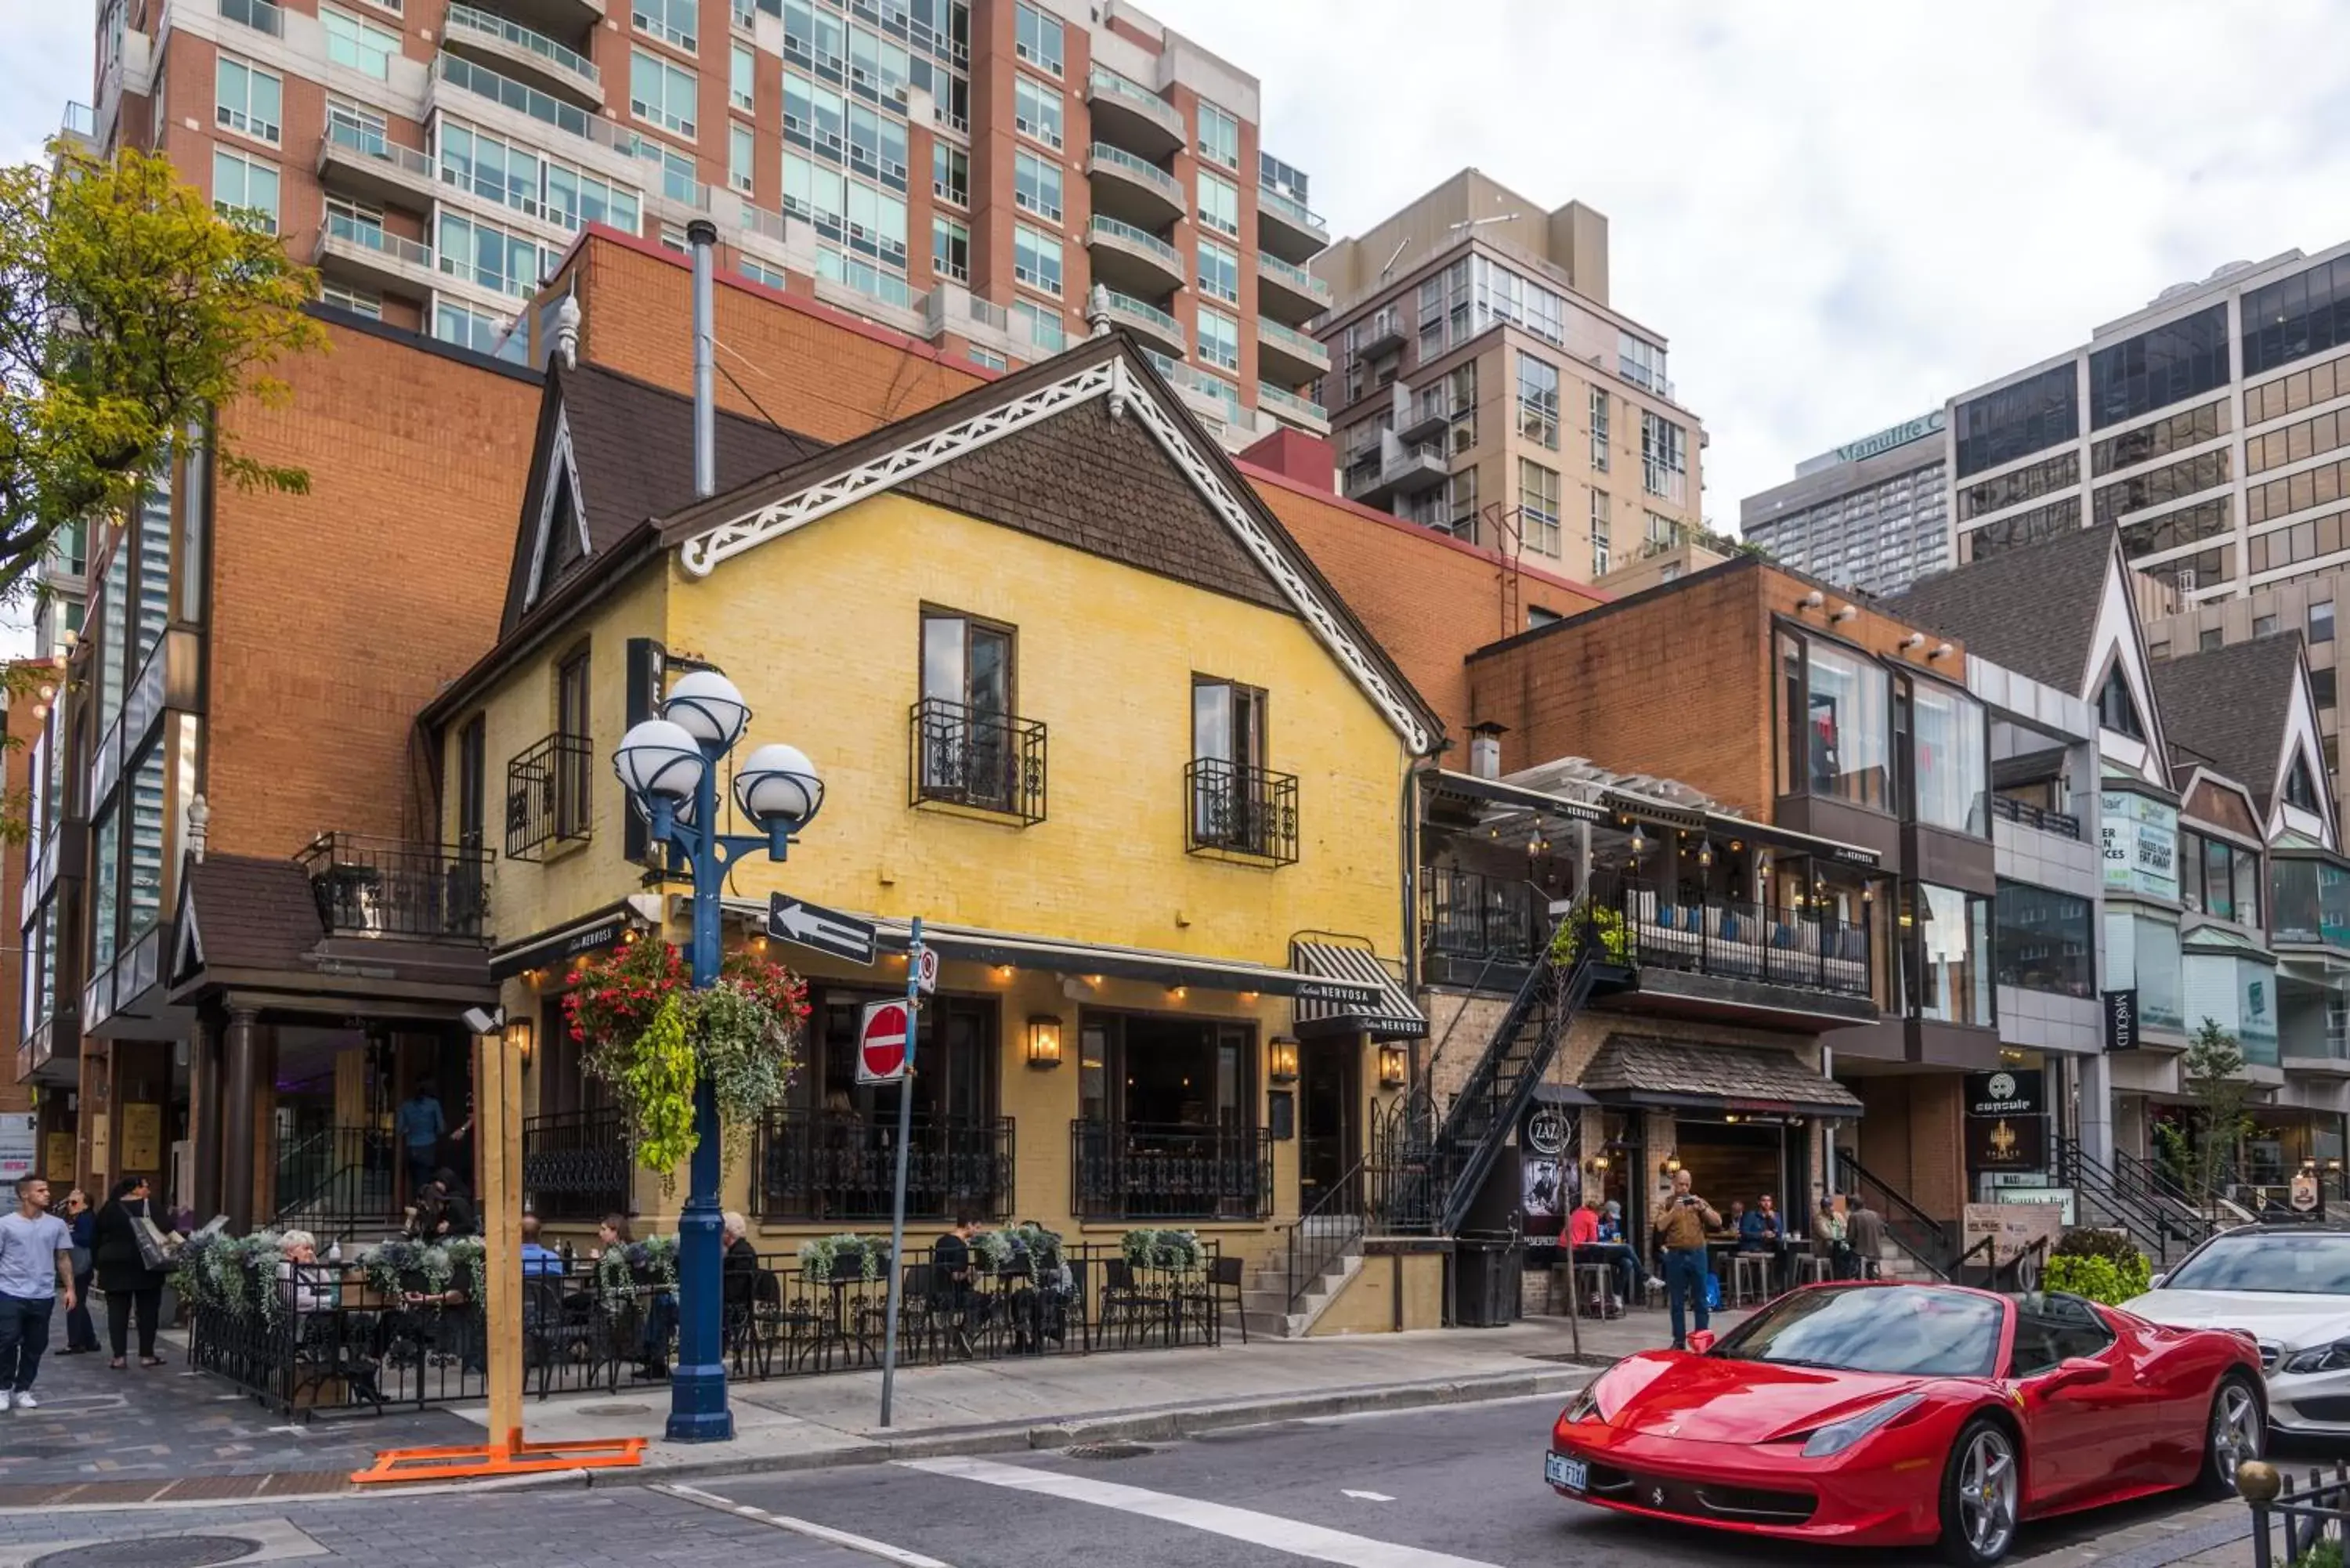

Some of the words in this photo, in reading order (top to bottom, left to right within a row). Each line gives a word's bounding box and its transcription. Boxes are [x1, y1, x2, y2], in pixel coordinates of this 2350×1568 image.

[1836, 421, 1922, 461] Manulife
[1567, 806, 1600, 820] NERVOSA
[1321, 986, 1369, 1002] NERVOSA
[1381, 1019, 1424, 1034] NERVOSA
[1535, 1122, 1563, 1140] ZAZ
